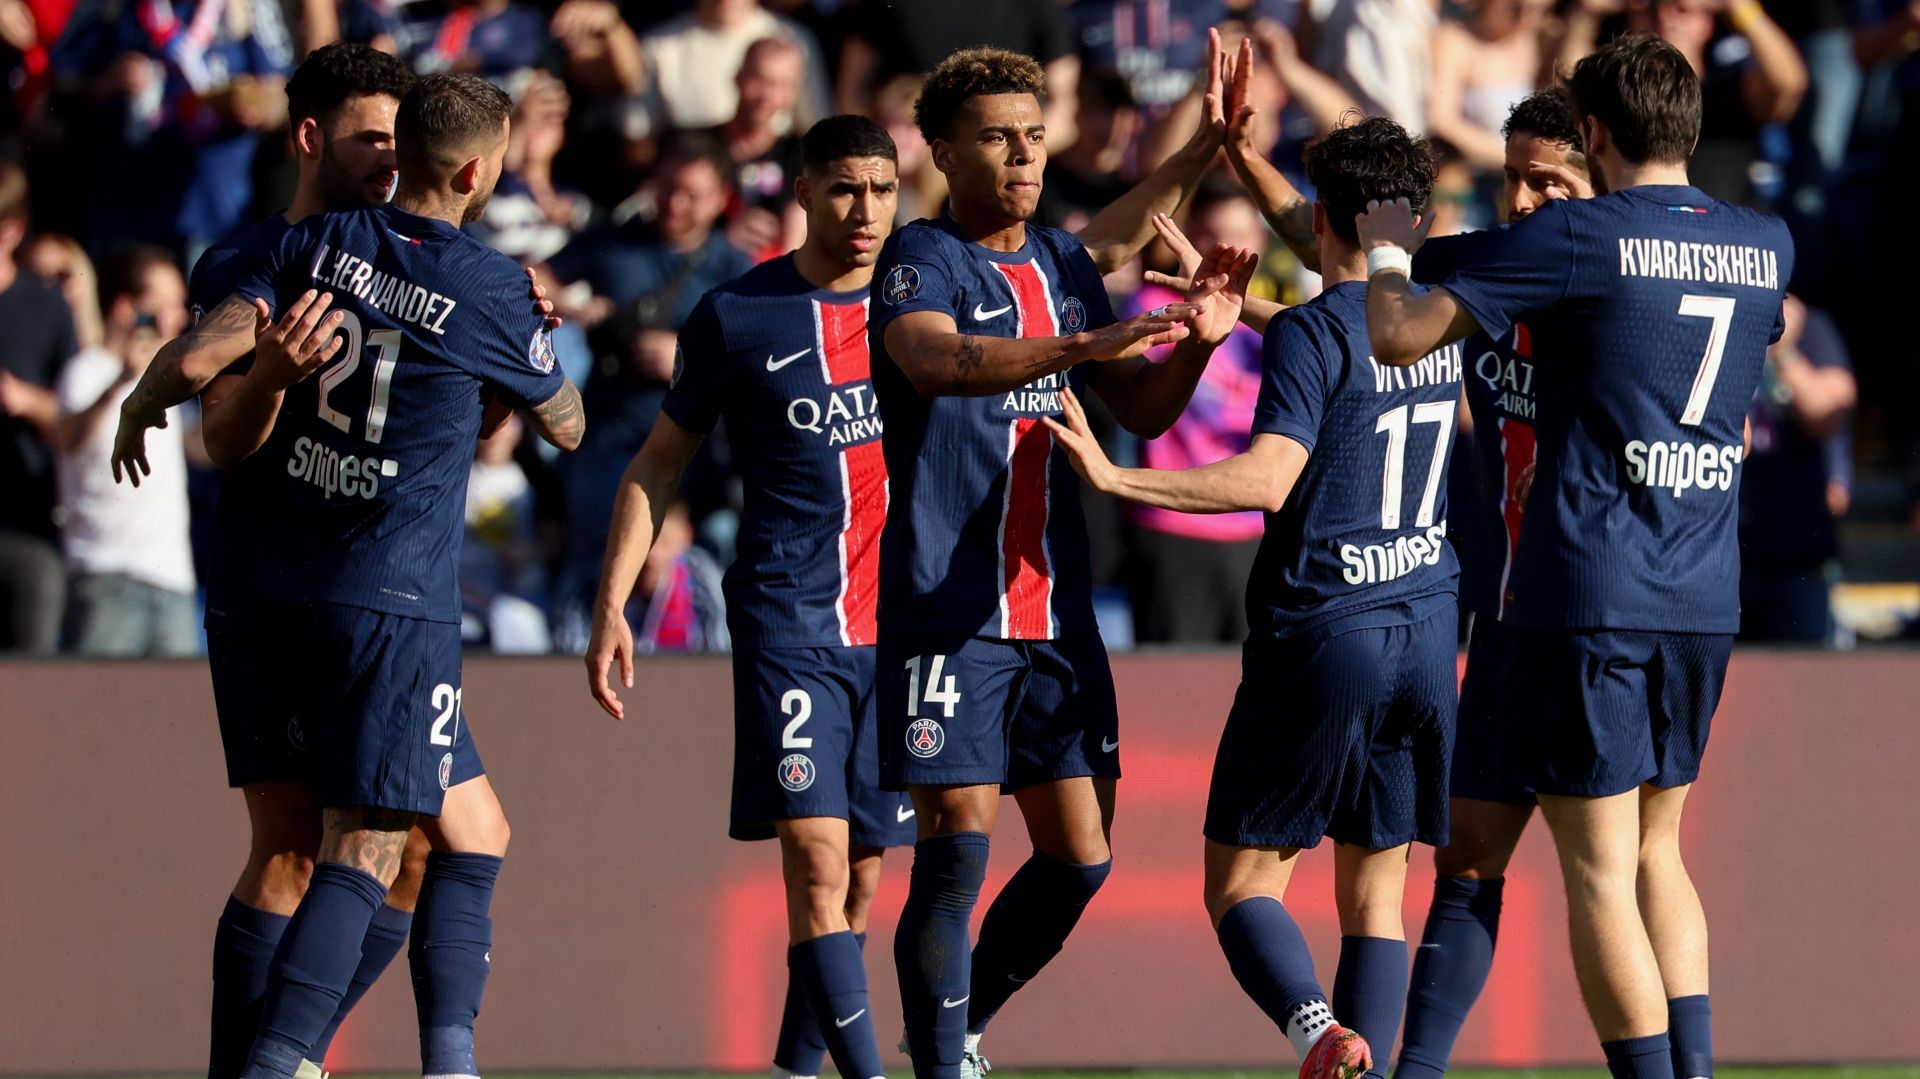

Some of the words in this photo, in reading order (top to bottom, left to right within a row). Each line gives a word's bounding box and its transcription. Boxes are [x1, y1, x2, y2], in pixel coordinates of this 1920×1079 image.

[1618, 238, 1778, 290] KVARATSKHELIA
[317, 308, 402, 445] 21
[1475, 351, 1536, 396] QAT
[1677, 294, 1737, 427] 7
[1375, 400, 1456, 530] 17
[904, 654, 962, 718] 14
[781, 688, 813, 749] 2
[912, 720, 938, 731] PARIS
